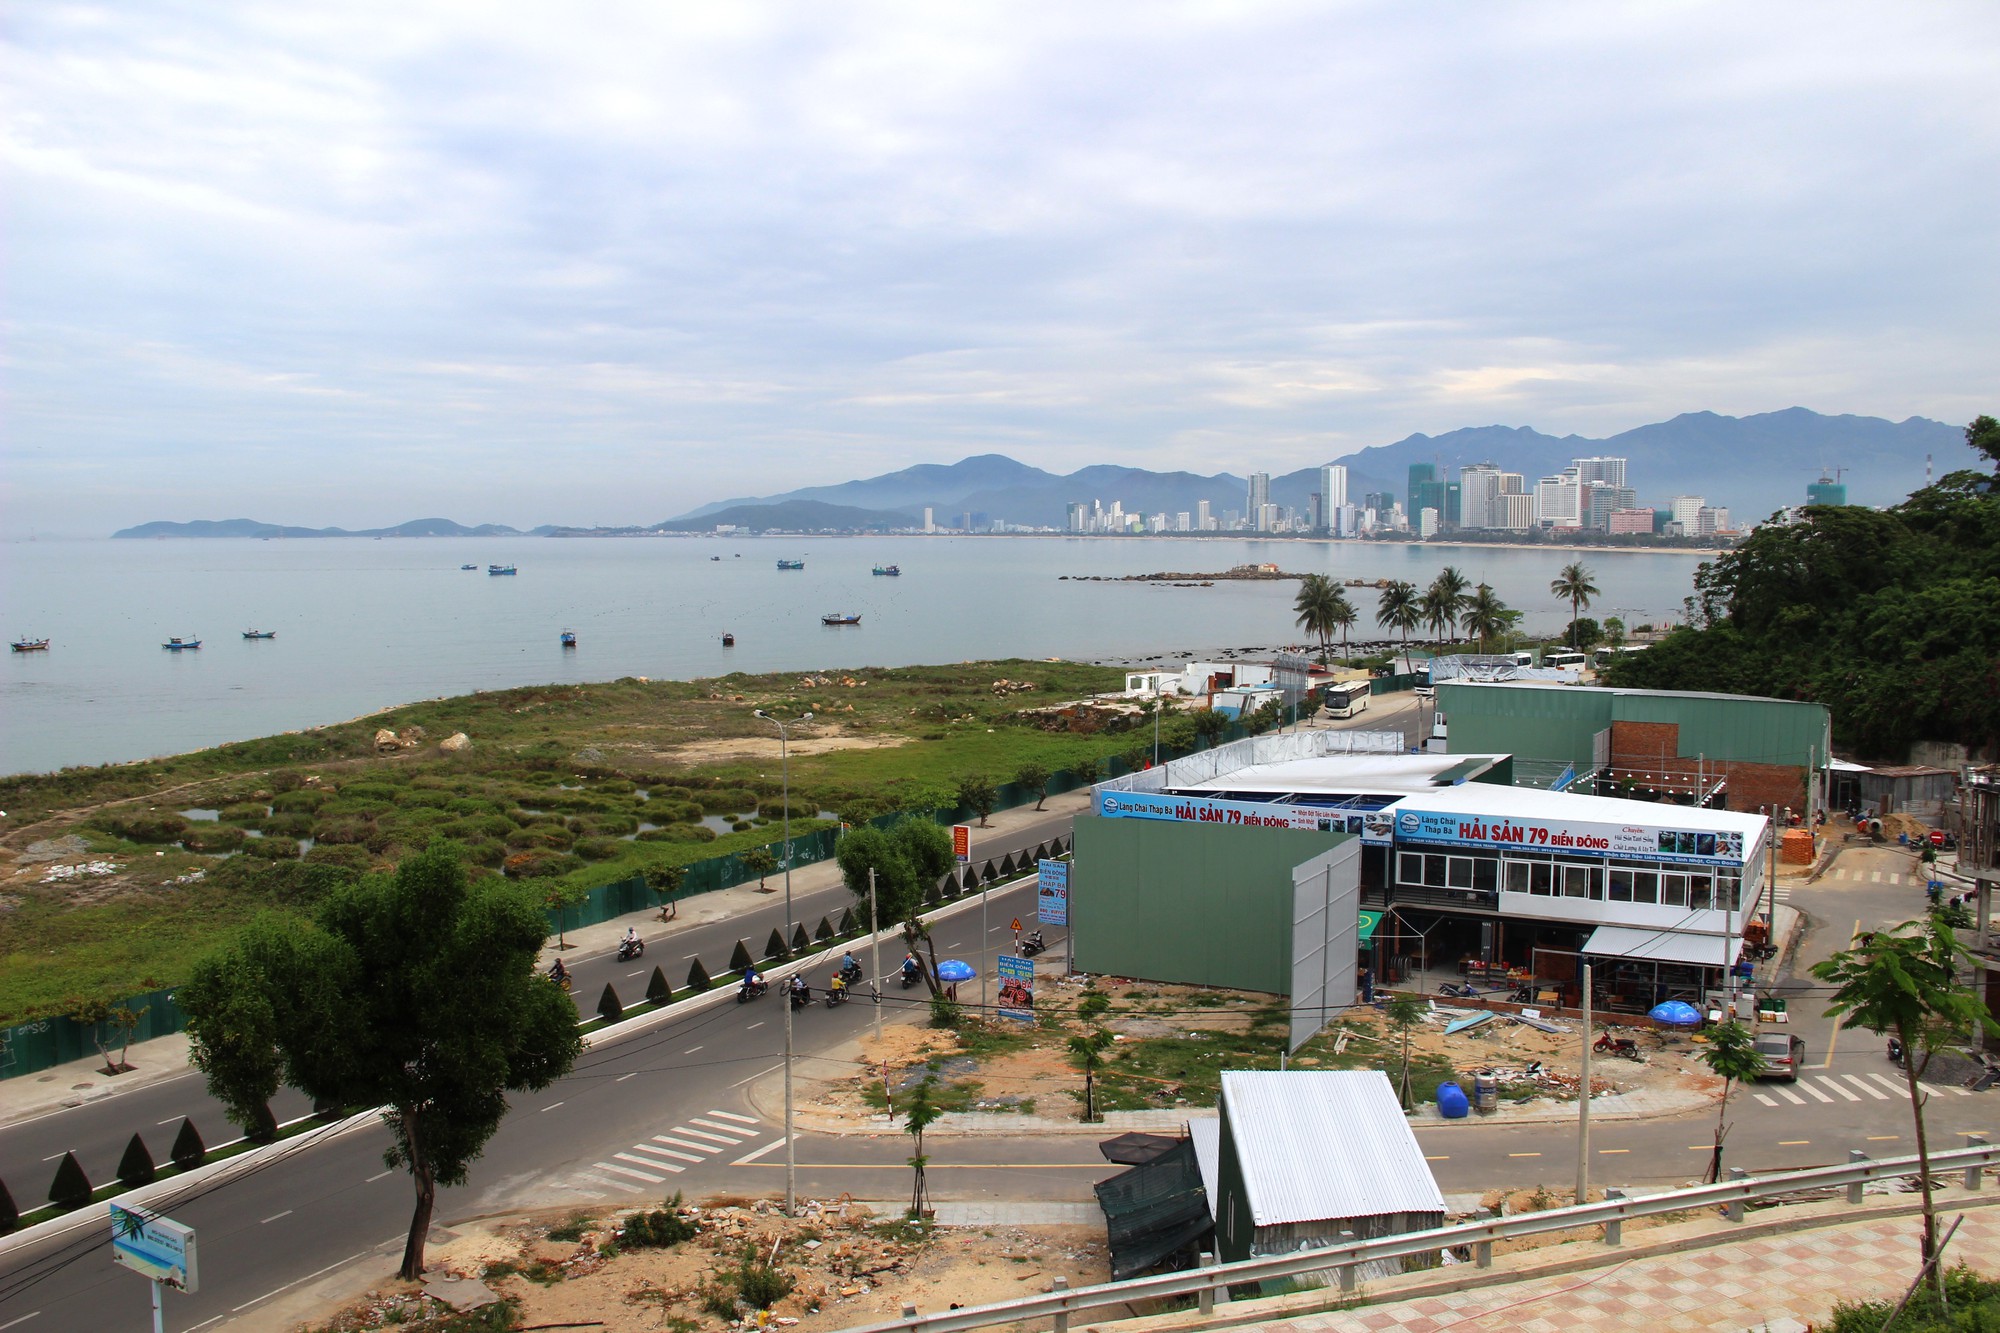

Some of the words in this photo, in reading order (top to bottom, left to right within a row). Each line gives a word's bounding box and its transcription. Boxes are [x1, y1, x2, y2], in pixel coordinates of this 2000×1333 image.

[1175, 801, 1196, 820] HẢI
[1199, 802, 1223, 823] SẢN
[1227, 809, 1241, 825] 79
[1243, 811, 1261, 826] BIỂN
[1263, 815, 1289, 829] ĐÔNG
[1459, 817, 1487, 840] HẢI
[1491, 819, 1524, 843] SẢN
[1529, 827, 1549, 845] 79
[1550, 829, 1574, 847] BIỂN
[1576, 834, 1609, 849] ĐÔNG
[1055, 889, 1066, 899] 79
[1008, 988, 1027, 1002] 79
